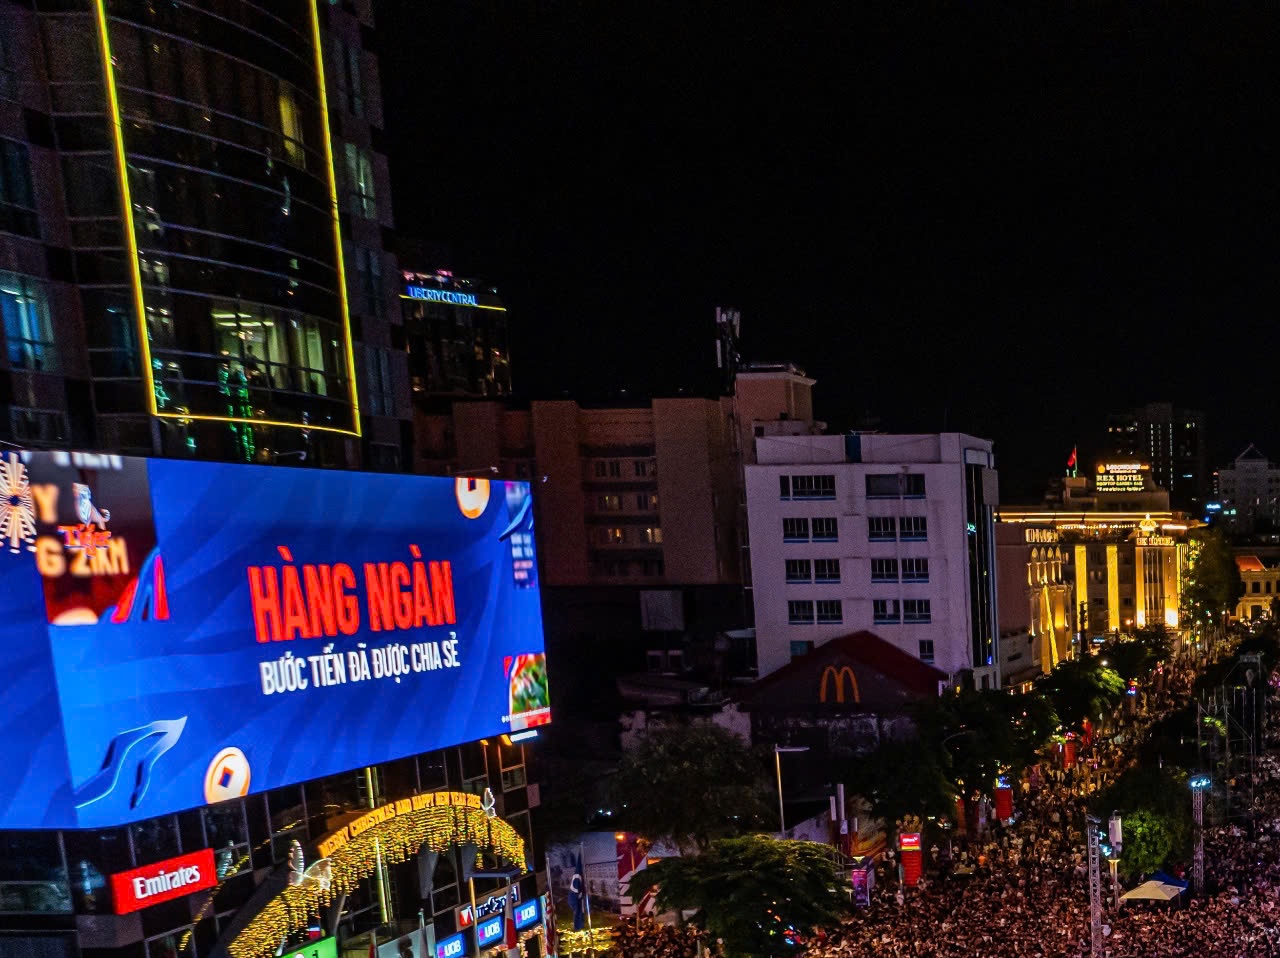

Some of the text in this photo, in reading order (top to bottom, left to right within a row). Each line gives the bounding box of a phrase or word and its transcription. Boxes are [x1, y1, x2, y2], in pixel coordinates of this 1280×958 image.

[248, 545, 360, 643] HÀNG
[363, 543, 456, 632] NGÀN
[259, 631, 461, 695] BƯỚC TIẾN ĐÃ ĐƯỢC CHIA SẺ
[320, 826, 350, 858] MERRY
[350, 803, 395, 837] CHRISTMAS
[395, 799, 412, 816] AND
[412, 793, 435, 812] HAPPY
[435, 792, 450, 806] NEW
[133, 865, 200, 899] Emirates
[484, 921, 500, 938] UOB
[520, 905, 535, 920] UOB
[444, 940, 461, 956] UOB
